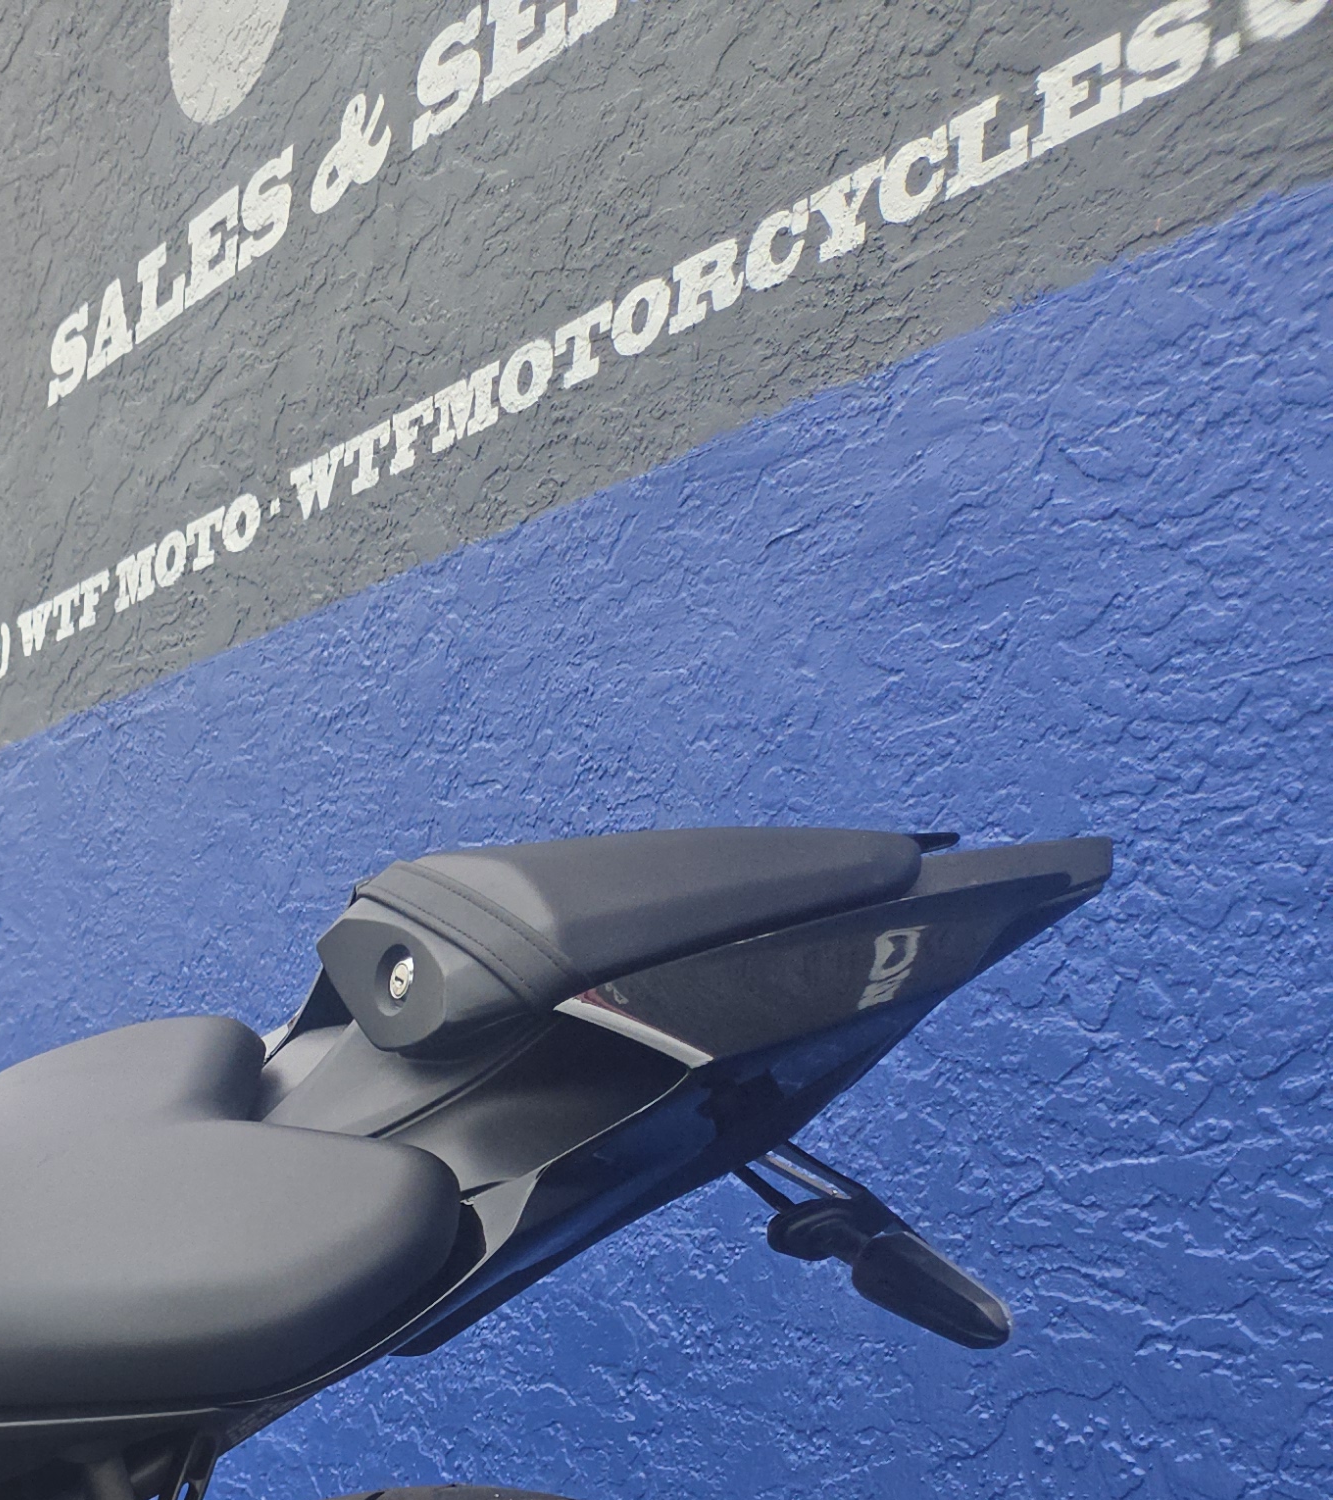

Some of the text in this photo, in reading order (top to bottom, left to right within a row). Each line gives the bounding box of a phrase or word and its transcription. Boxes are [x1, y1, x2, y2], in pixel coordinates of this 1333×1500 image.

[47, 0, 619, 408] SALES & SE
[16, 567, 110, 657] WTF
